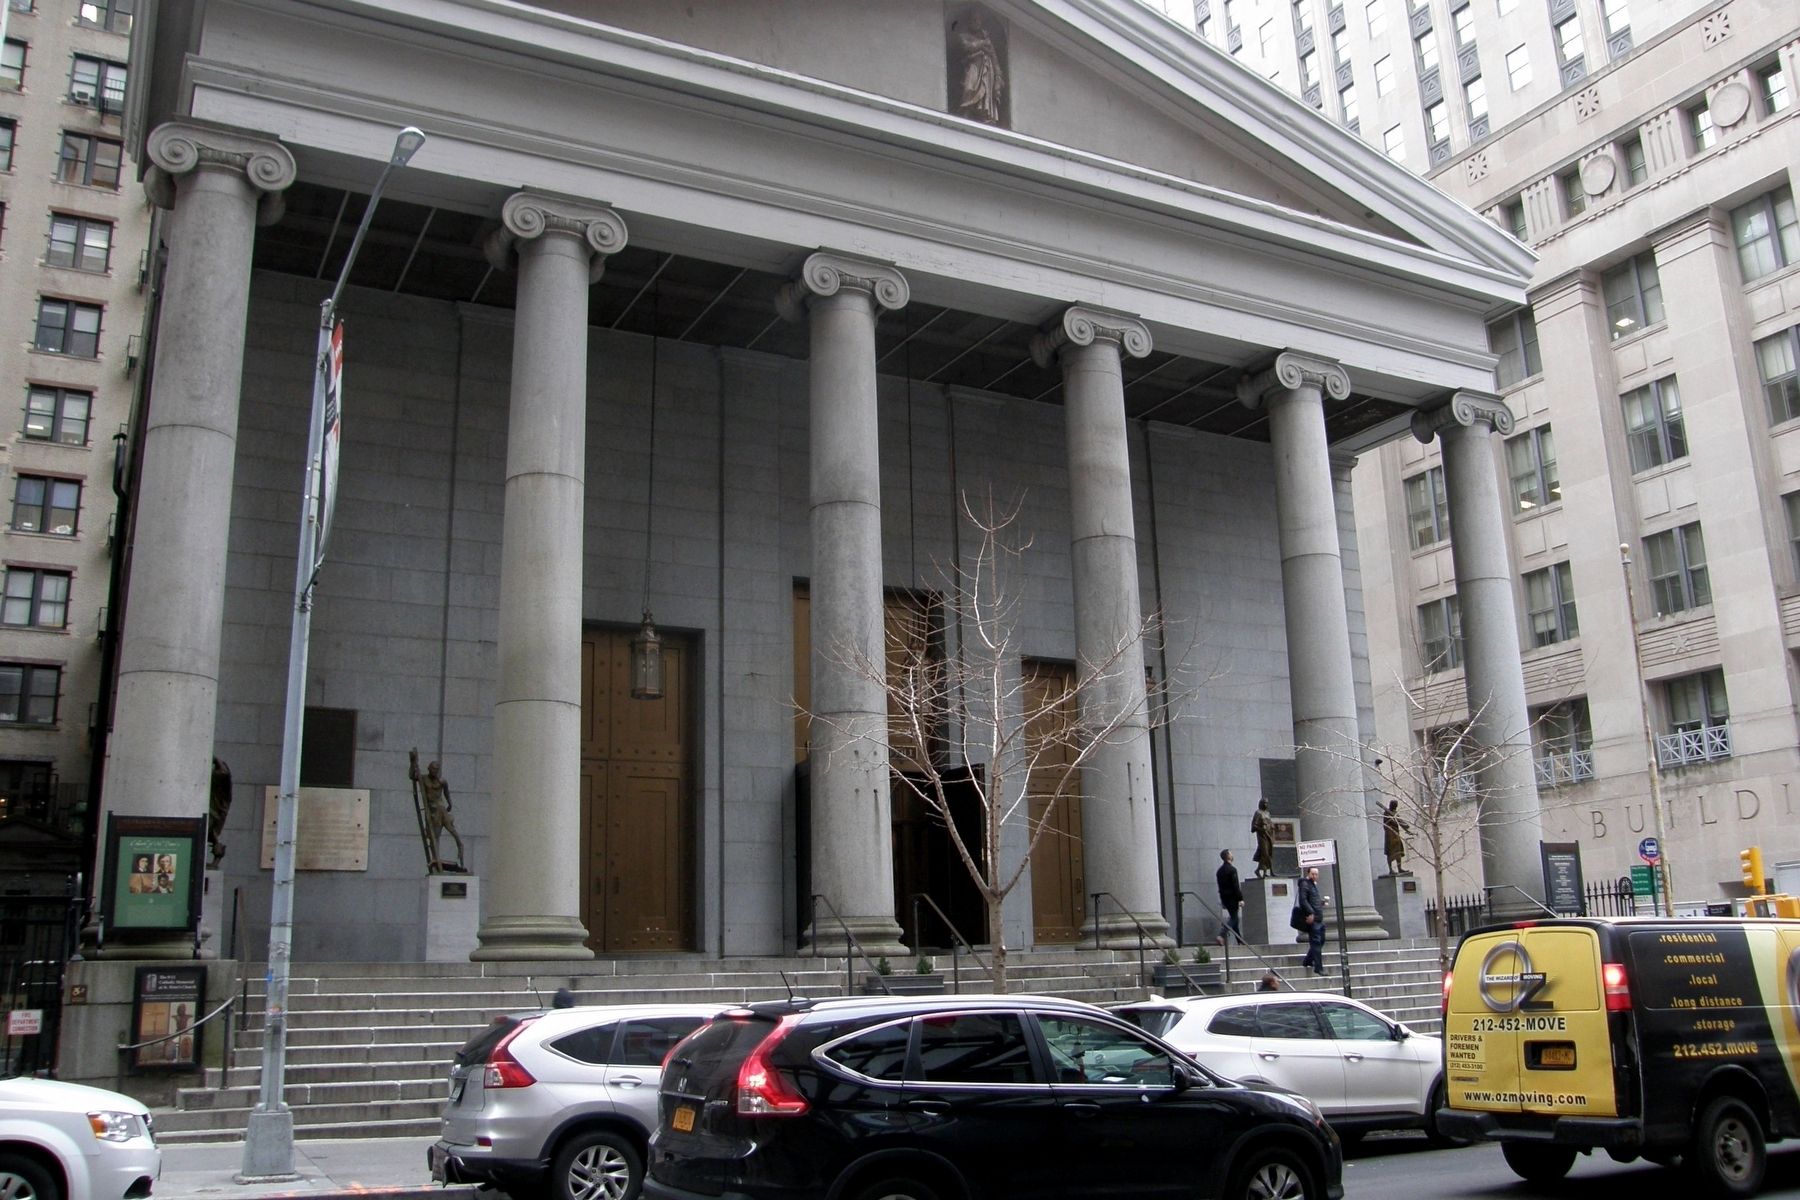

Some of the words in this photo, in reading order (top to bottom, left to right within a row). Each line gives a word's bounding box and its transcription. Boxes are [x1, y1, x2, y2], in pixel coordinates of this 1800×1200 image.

[1700, 996, 1743, 1006] distance
[1473, 1017, 1566, 1031] 212-452-MOVE
[1450, 1034, 1476, 1042] DRIVERS
[1450, 1043, 1479, 1051] FOREMEN
[1673, 1041, 1758, 1057] 212.452.move
[1450, 1052, 1476, 1060] WANTED
[1464, 1091, 1586, 1106] www.ozmoving.com
